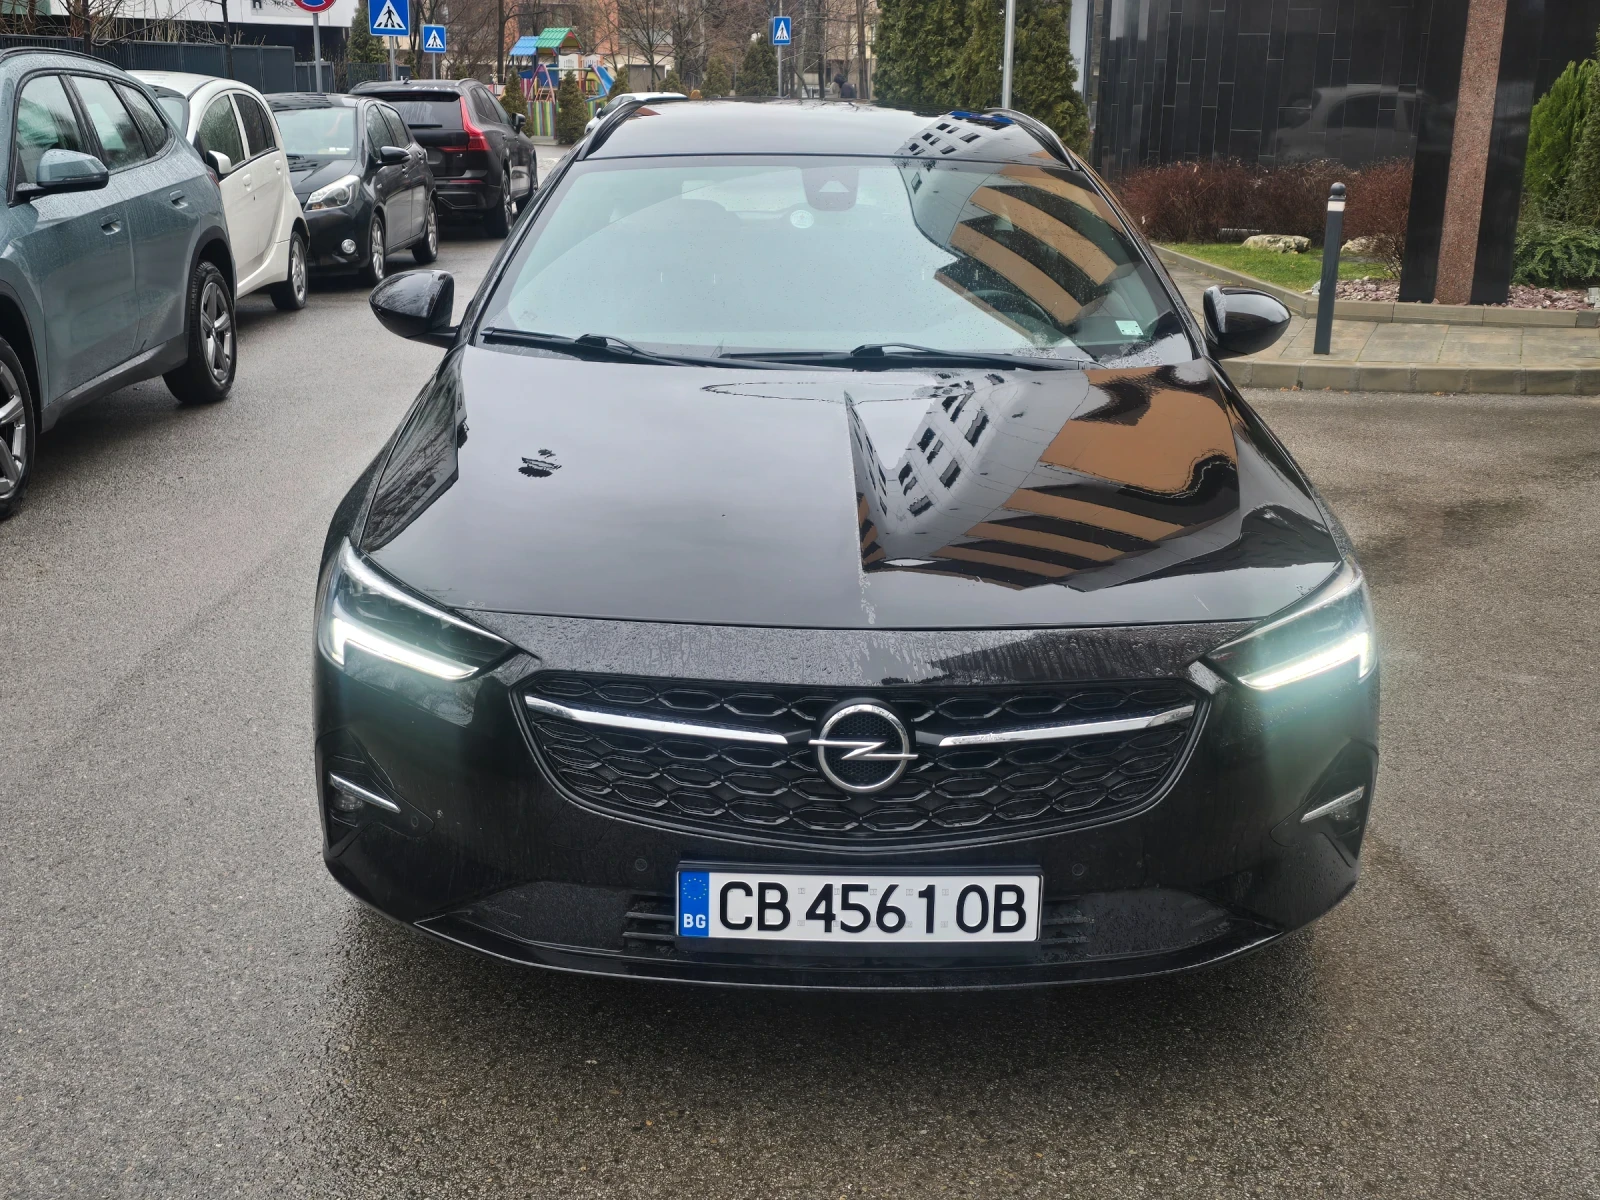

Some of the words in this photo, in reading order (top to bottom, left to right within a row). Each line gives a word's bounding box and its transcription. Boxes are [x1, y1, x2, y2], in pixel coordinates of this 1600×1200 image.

[683, 913, 706, 929] BG
[719, 880, 791, 931] CB
[805, 883, 936, 933] 4561
